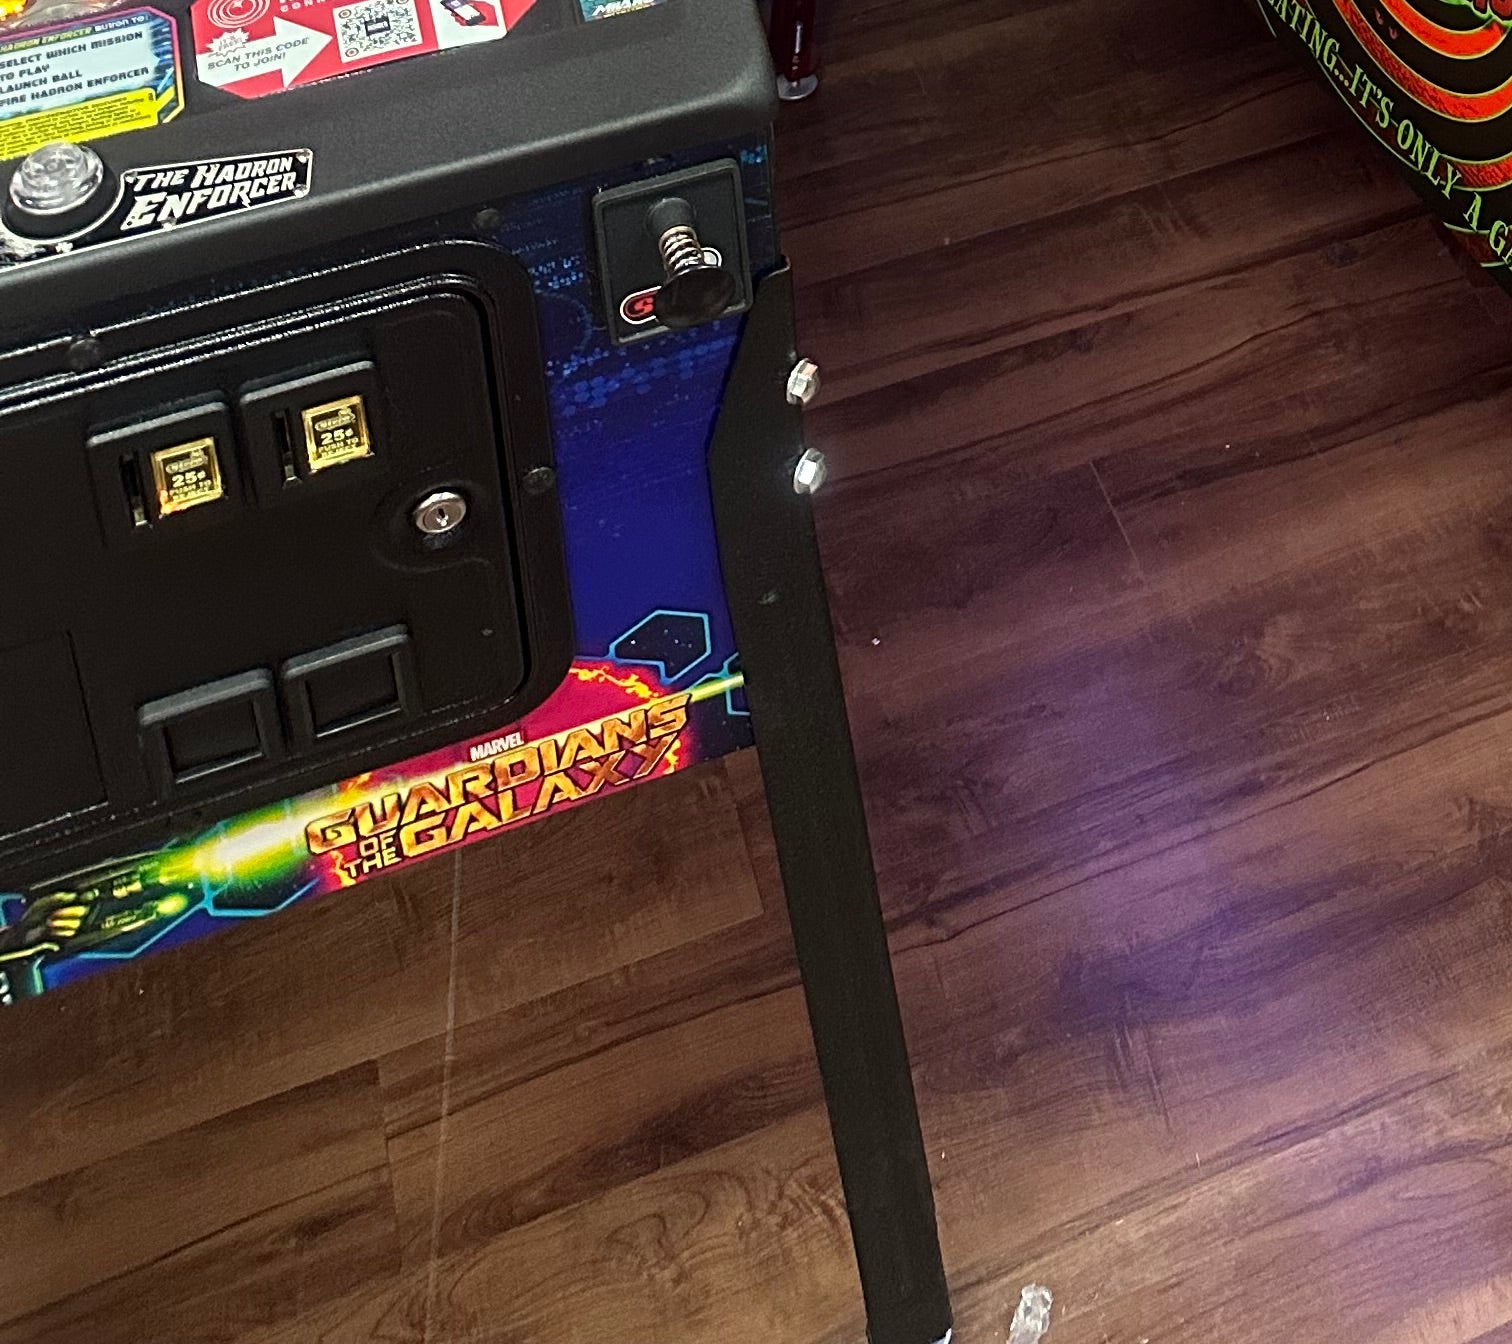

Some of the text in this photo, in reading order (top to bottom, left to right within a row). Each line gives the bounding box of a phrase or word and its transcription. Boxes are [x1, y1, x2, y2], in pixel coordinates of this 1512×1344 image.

[42, 18, 130, 44] ENFORCER BUTTON
[0, 31, 143, 69] SELECT WHICH MISSION
[207, 37, 310, 71] SCAN THIS CODE
[234, 51, 286, 72] TO JOIN!
[0, 64, 50, 82] TO PLAY
[0, 70, 82, 93] LAUNCH BALL
[0, 67, 149, 107] FIRE HADRON ENFORCER
[134, 156, 293, 192] THE HADRON
[1396, 117, 1461, 200] ONLY
[1463, 193, 1483, 232] A
[120, 172, 297, 231] ENFORCER
[319, 438, 359, 453] PUSH TO
[321, 428, 353, 445] 25¢
[170, 480, 211, 496] PUSH TO
[172, 471, 206, 488] 25¢
[470, 732, 524, 761] MARVEL
[306, 693, 692, 855] GUARDIANS
[400, 733, 680, 858] GALAXY
[359, 829, 395, 857] OF
[344, 849, 400, 878] THE
